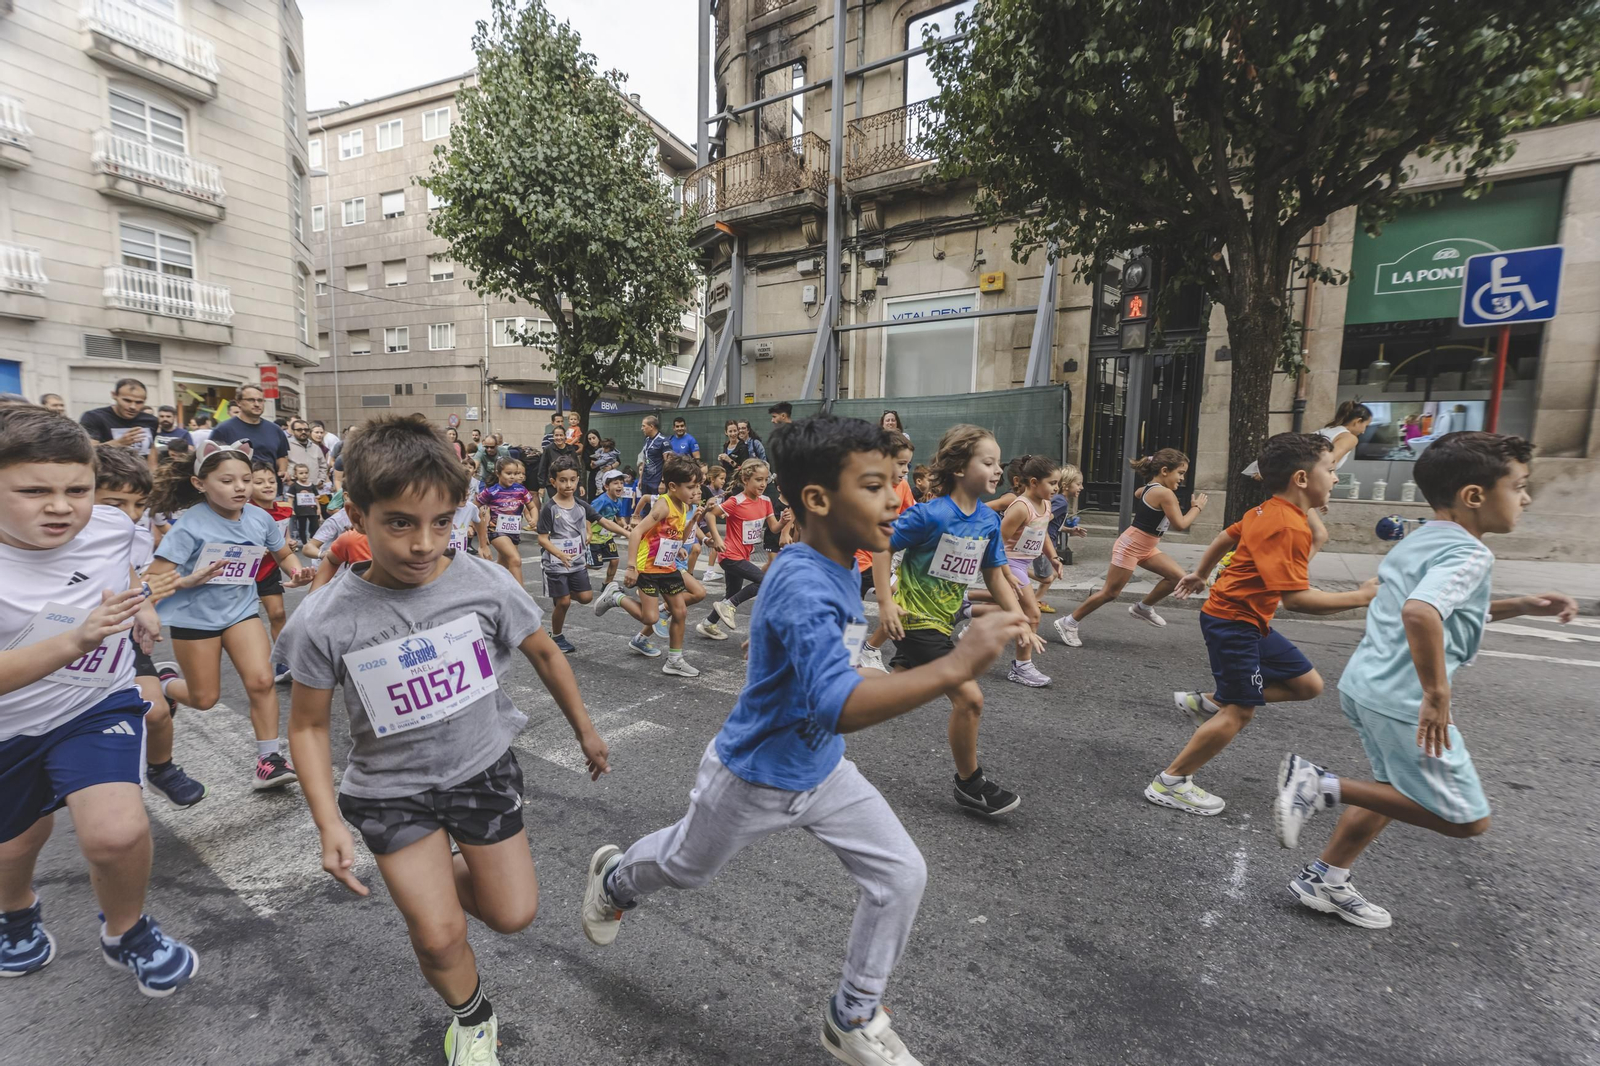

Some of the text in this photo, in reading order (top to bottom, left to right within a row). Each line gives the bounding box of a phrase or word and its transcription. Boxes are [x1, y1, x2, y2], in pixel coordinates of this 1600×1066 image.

[1391, 271, 1414, 285] LA
[601, 401, 618, 411] BBVA
[940, 554, 978, 575] 5206
[45, 613, 75, 624] 2026
[358, 657, 388, 672] 2026
[410, 663, 433, 676] MAEL
[386, 660, 471, 716] 5052
